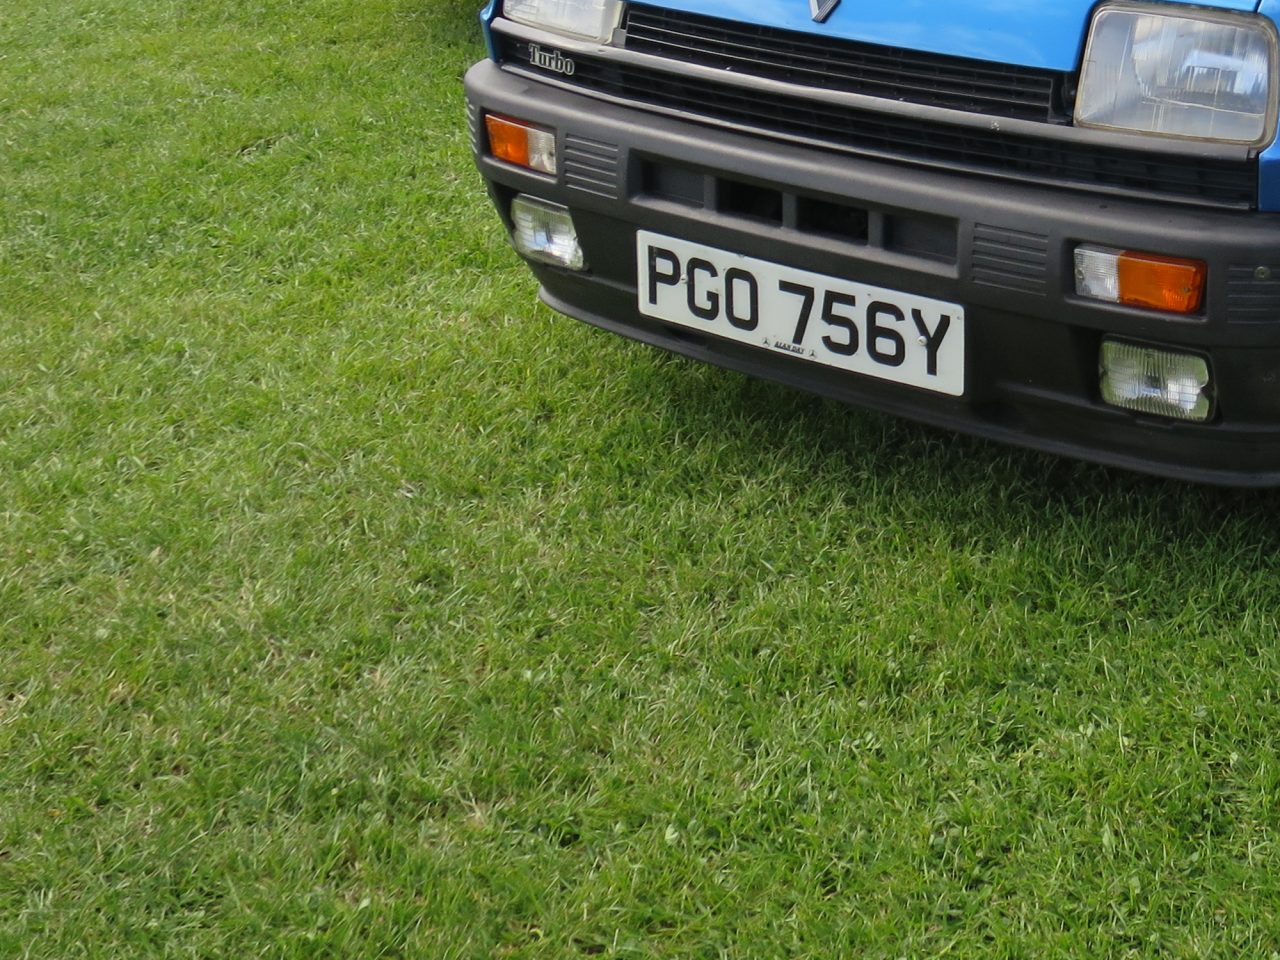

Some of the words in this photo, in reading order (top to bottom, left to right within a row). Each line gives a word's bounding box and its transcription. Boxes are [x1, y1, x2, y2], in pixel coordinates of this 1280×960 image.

[528, 43, 575, 76] Turbo
[647, 245, 759, 332] PGO
[778, 279, 951, 377] 756Y
